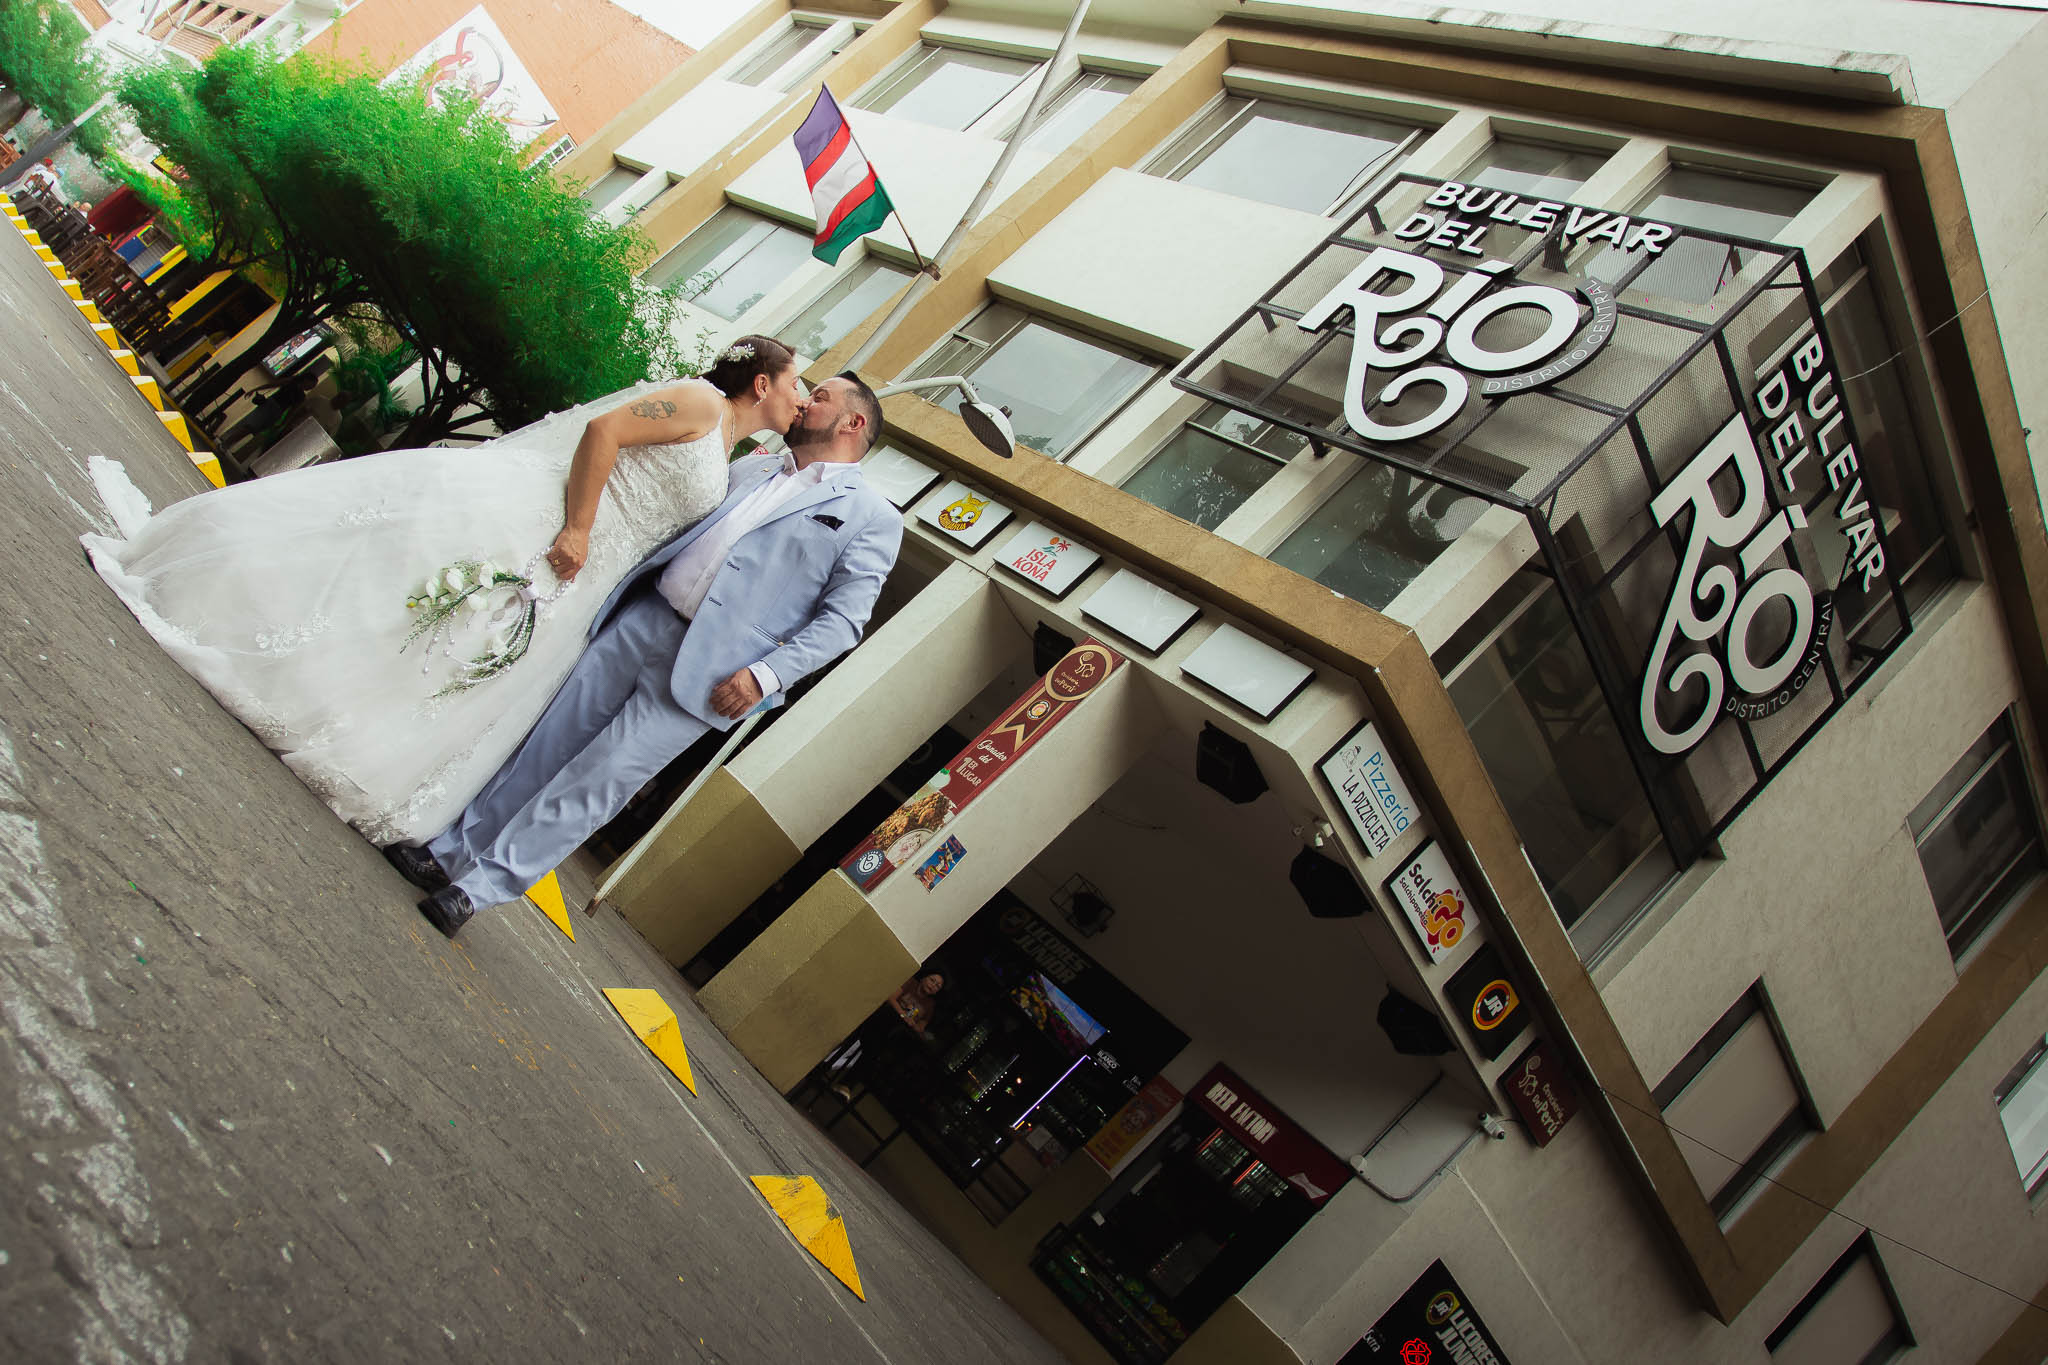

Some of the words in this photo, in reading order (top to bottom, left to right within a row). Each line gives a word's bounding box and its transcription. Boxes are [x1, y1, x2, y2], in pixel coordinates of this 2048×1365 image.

[1394, 212, 1485, 256] DEL
[1424, 181, 1675, 254] BULEVAR
[1485, 346, 1589, 393] DISTRITO
[1585, 277, 1616, 347] CENTRAL
[1756, 372, 1813, 494] DEL
[1790, 331, 1887, 594] BULEVAR
[1011, 556, 1049, 582] KONA
[1025, 548, 1057, 571] ISLA
[1725, 686, 1790, 718] DISTRITO
[1793, 596, 1833, 690] CENTRAL
[976, 739, 1008, 762] Ganador
[978, 754, 993, 764] del
[959, 767, 982, 786] LUGAR
[1363, 751, 1409, 833] Pizzería
[1341, 774, 1360, 798] LA
[1351, 790, 1391, 853] PIZZICLETA
[1011, 933, 1078, 984] JUNIOR
[1023, 919, 1090, 972] LICORES
[1483, 994, 1504, 1017] JR
[1204, 1080, 1239, 1112] BEER
[1229, 1101, 1278, 1145] FACTORY
[1434, 1301, 1450, 1316] JR
